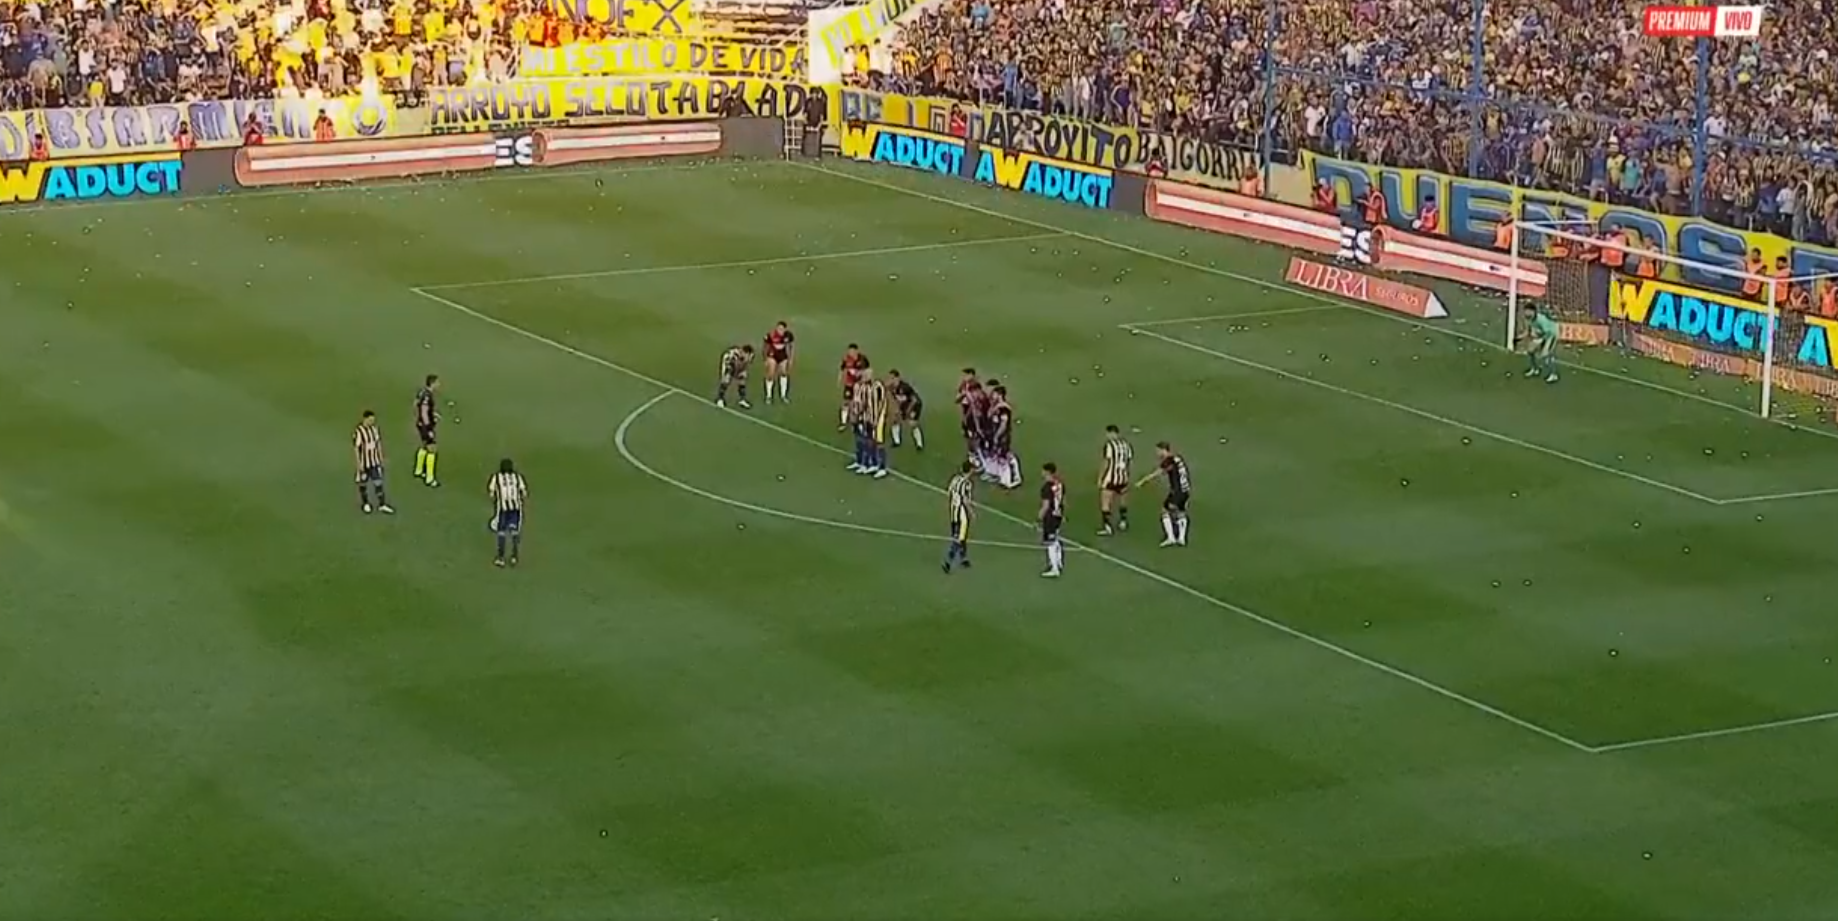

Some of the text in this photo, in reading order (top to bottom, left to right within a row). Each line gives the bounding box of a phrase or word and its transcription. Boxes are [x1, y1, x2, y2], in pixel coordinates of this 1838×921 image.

[564, 41, 677, 73] ESTILO
[689, 41, 729, 68] DE
[739, 44, 807, 73] VIDA
[431, 85, 551, 125] ARROYO
[565, 81, 647, 117] SECO
[987, 109, 1131, 169] ARROYITO
[975, 146, 1114, 208] AWADUCT
[1296, 261, 1369, 300] LIBRA
